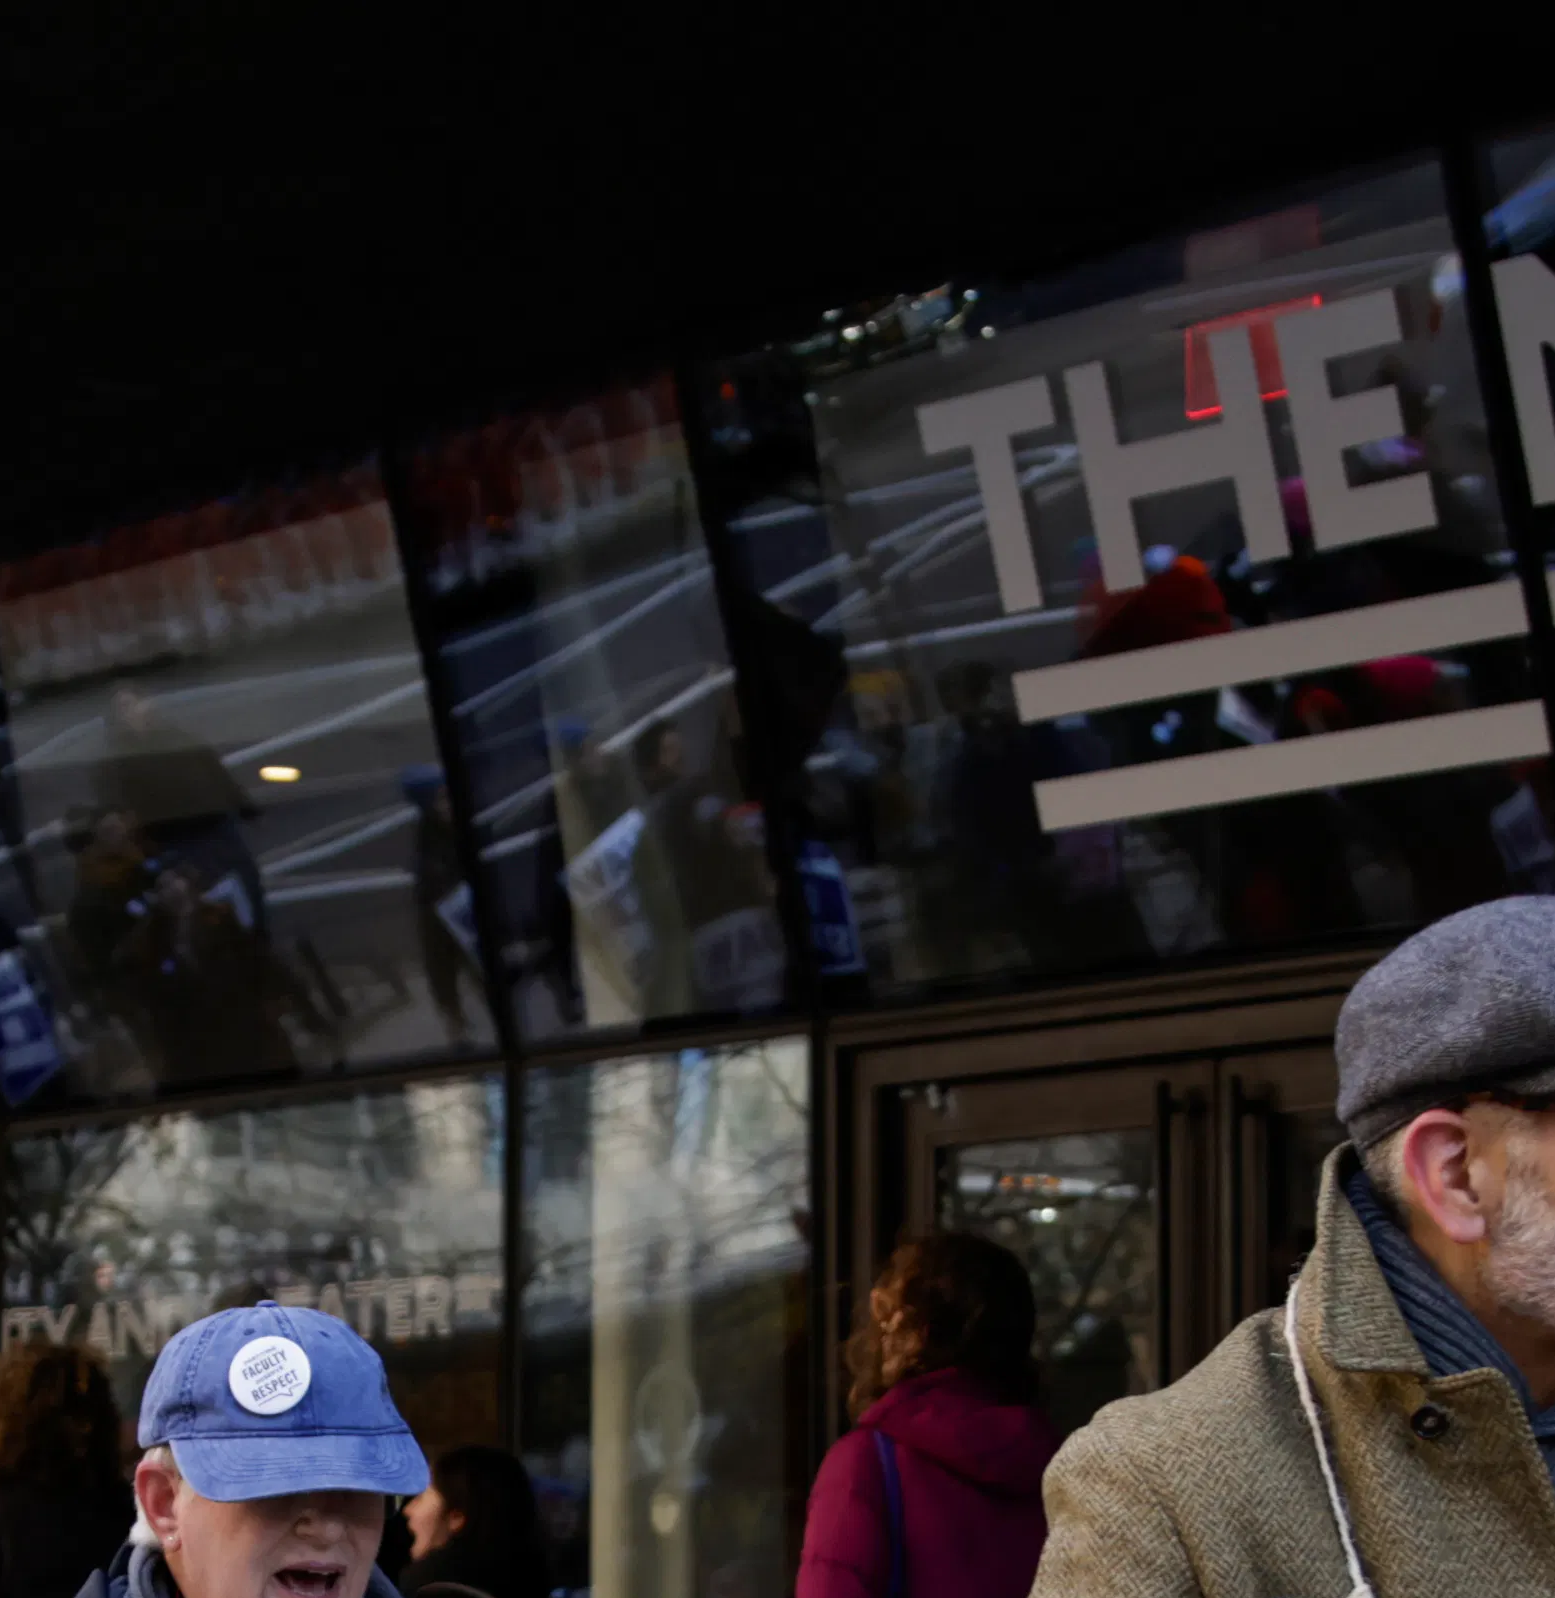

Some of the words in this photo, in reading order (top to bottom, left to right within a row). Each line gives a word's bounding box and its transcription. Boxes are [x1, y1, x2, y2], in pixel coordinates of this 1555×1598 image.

[917, 289, 1439, 616] THE
[241, 1349, 288, 1382] FACULTY
[250, 1369, 299, 1402] RESPECT
